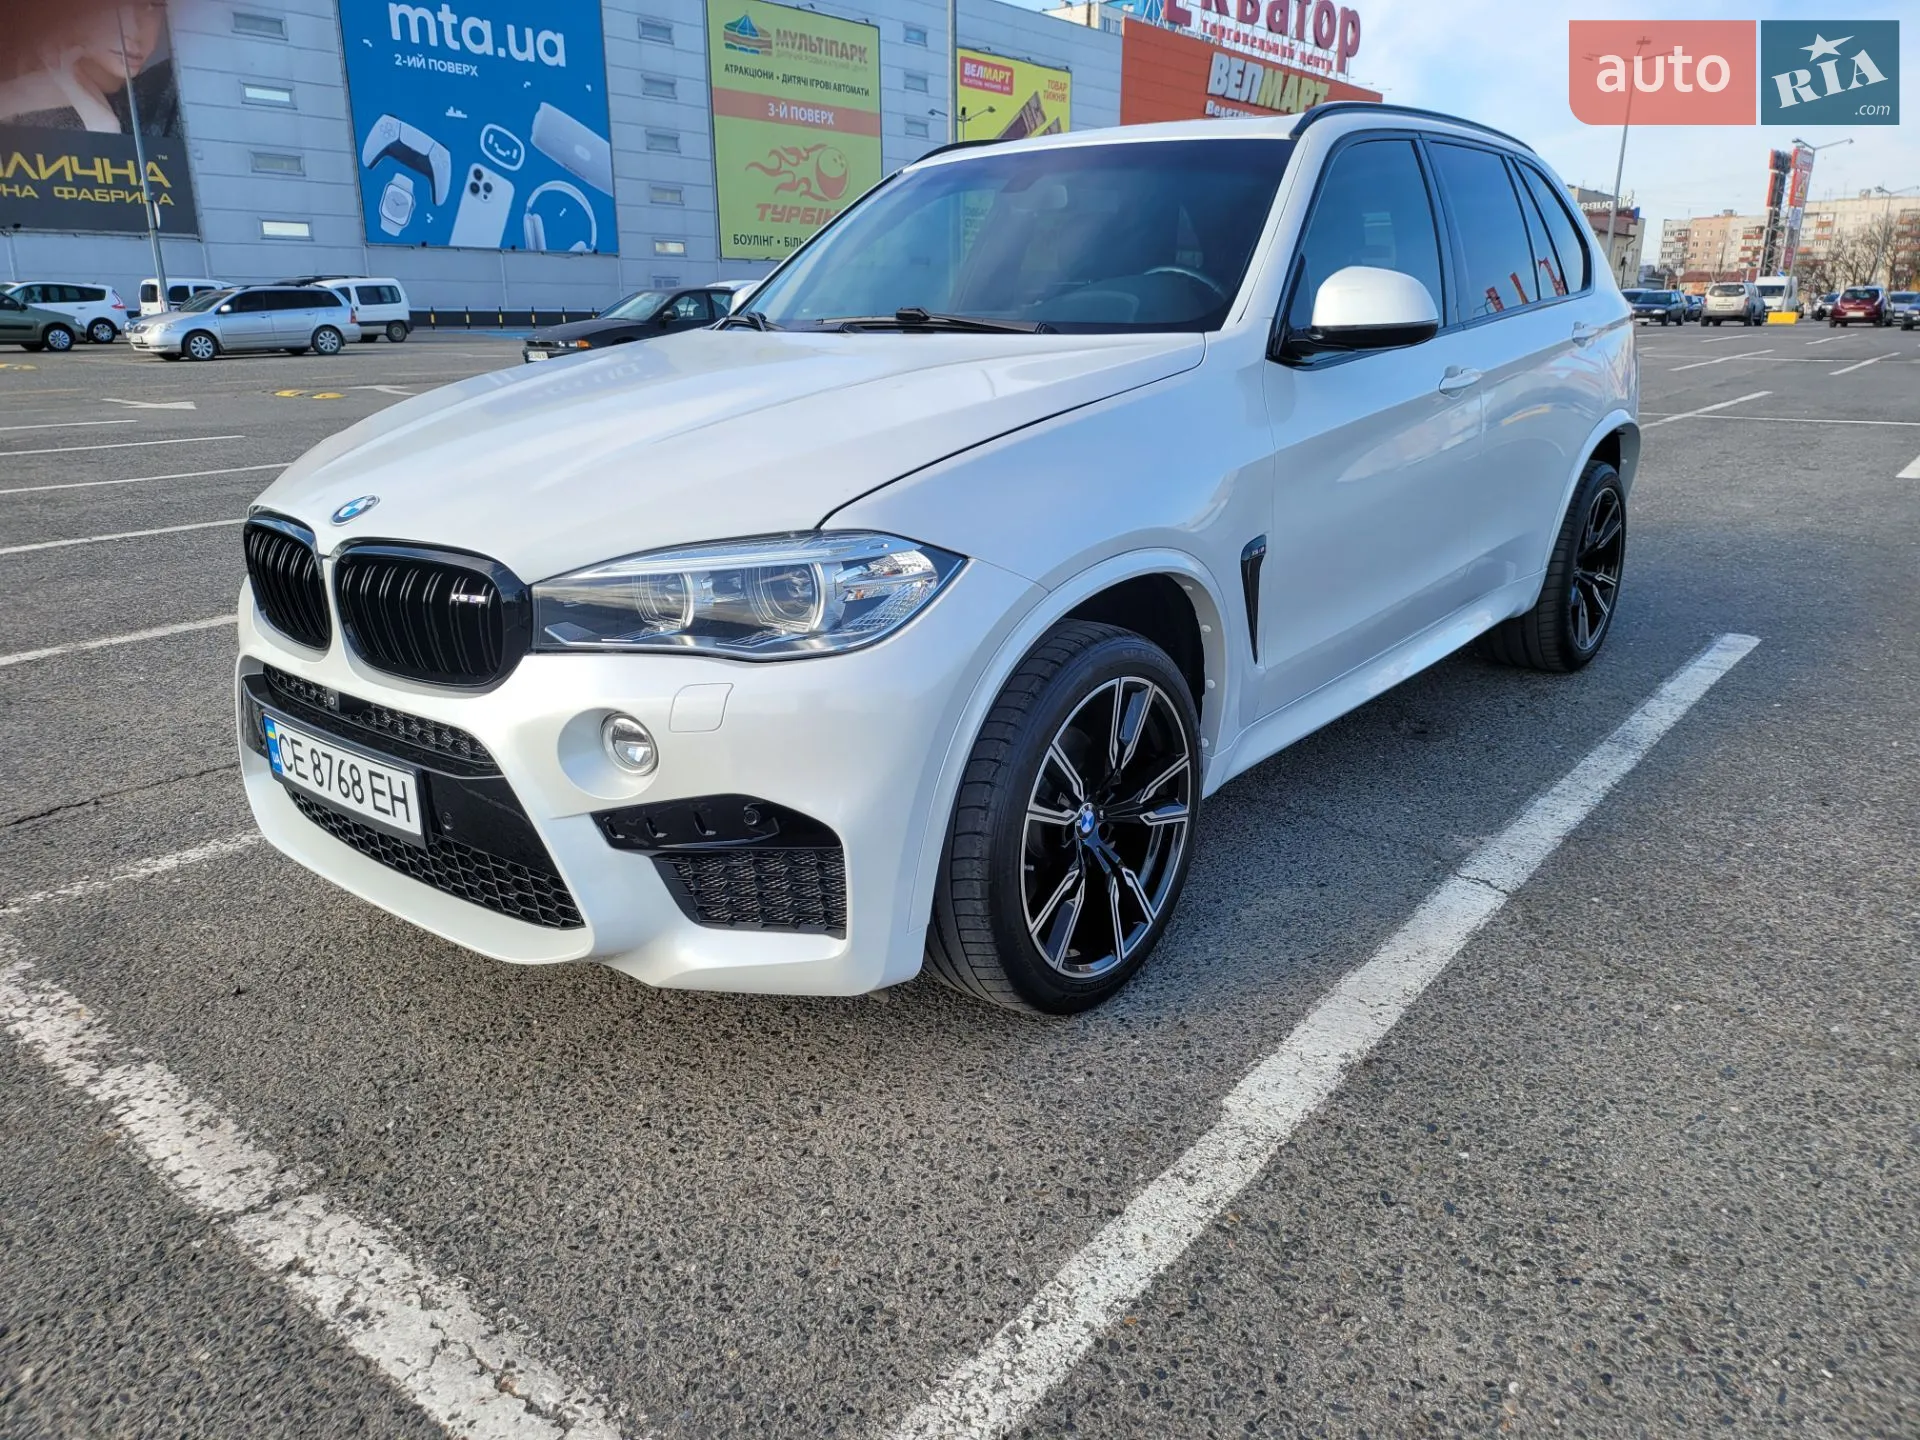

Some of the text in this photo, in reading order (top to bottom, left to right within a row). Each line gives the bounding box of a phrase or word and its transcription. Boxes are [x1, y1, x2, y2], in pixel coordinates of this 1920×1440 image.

[388, 2, 567, 67] mta.ua
[775, 28, 869, 64] МУЛЬТІПАРК
[394, 53, 479, 77] 2-ИЙ ПОВЕРХ
[724, 63, 870, 97] АТРАКЦІОНИ ДИТЯЧІ ІГРОВІ АВТОМАТИ
[964, 62, 1012, 84] ВЕЛМАРТ
[1207, 51, 1330, 113] ВЕЛМАРТ
[768, 102, 835, 125] 3-Й ПОВЕРХ
[0, 151, 172, 188] ЛИЧНА
[0, 183, 39, 199] НА
[733, 233, 809, 248] БОУЛІНГ БІЛЬ
[278, 733, 411, 823] CE 8768 EH
